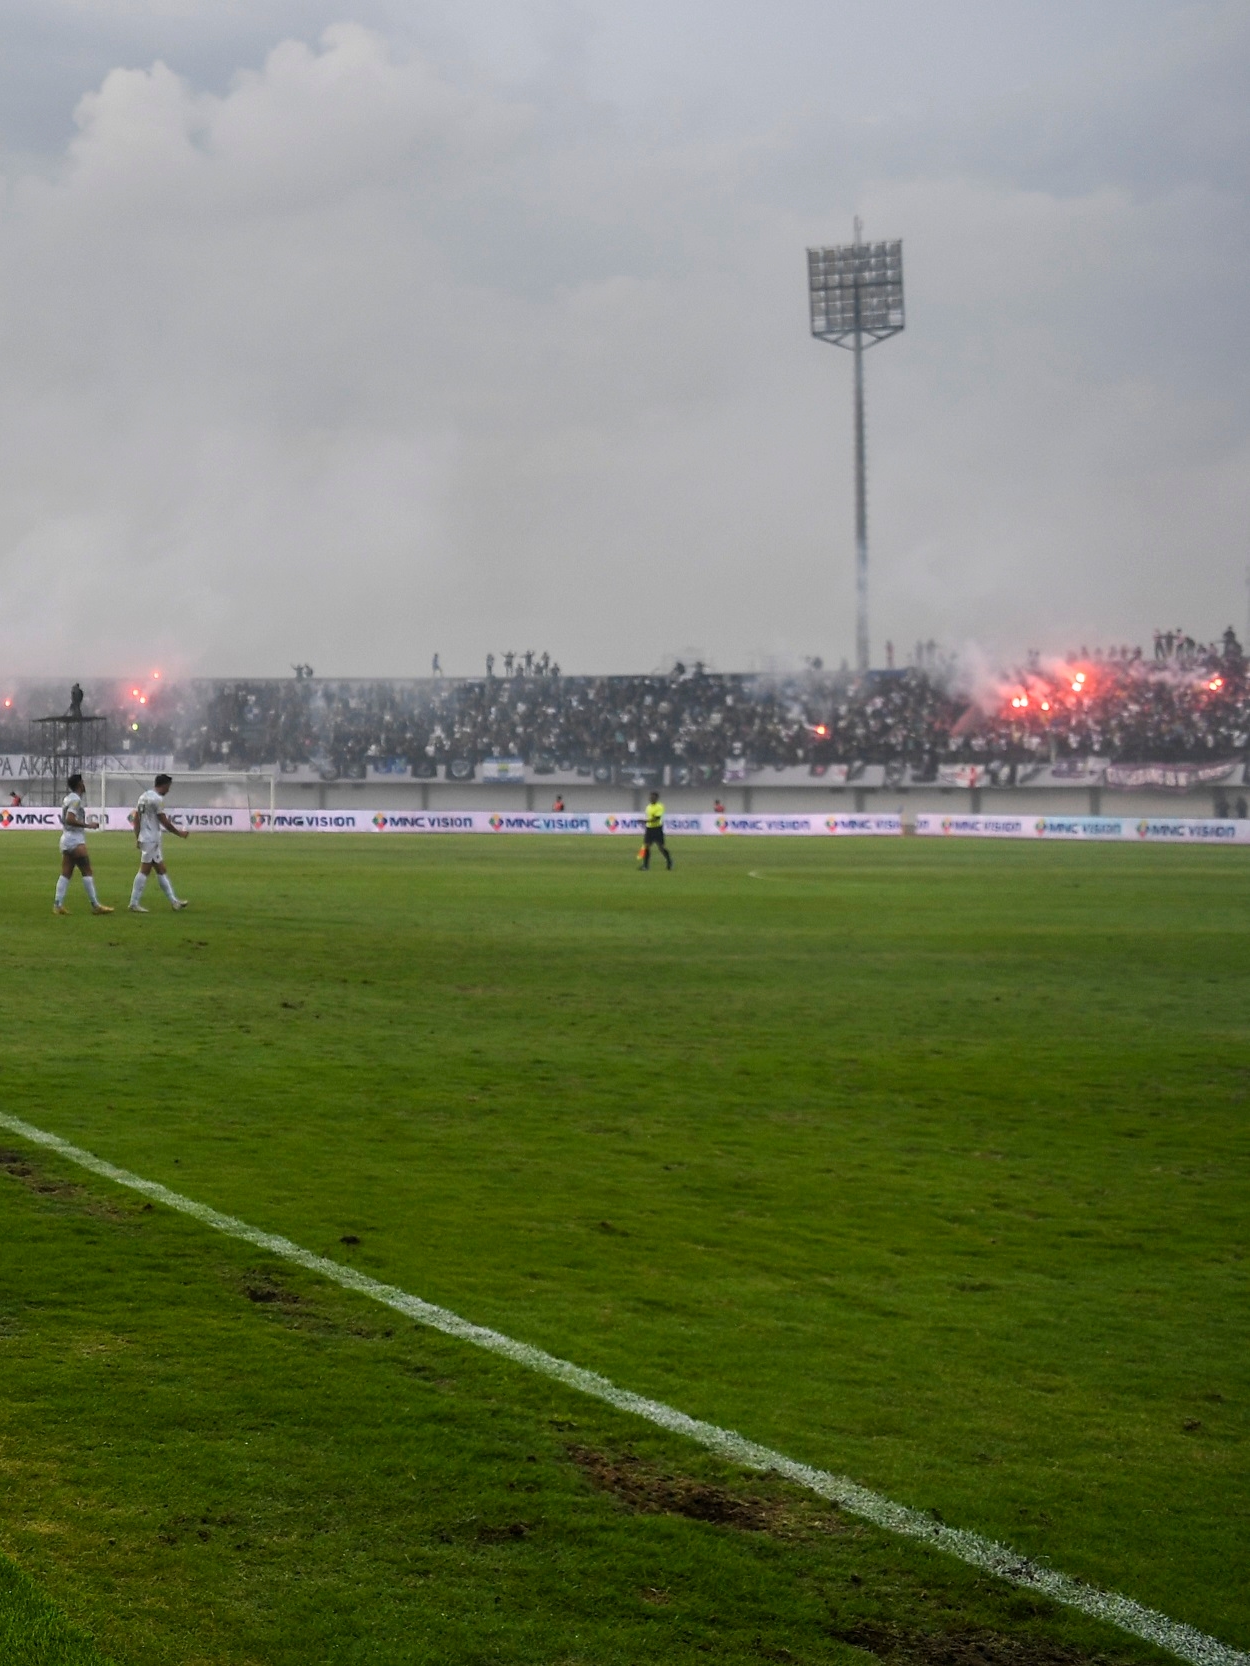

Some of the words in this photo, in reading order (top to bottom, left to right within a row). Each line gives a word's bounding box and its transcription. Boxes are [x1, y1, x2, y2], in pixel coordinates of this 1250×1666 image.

[16, 814, 56, 825] MNC
[273, 816, 304, 826] MNC
[389, 817, 425, 827] MNC
[505, 818, 541, 828] MNC
[840, 820, 872, 829] MNC
[729, 820, 762, 830] MNC
[951, 821, 981, 832] MNC
[1045, 823, 1078, 833] MNC
[1150, 826, 1184, 836] MNC
